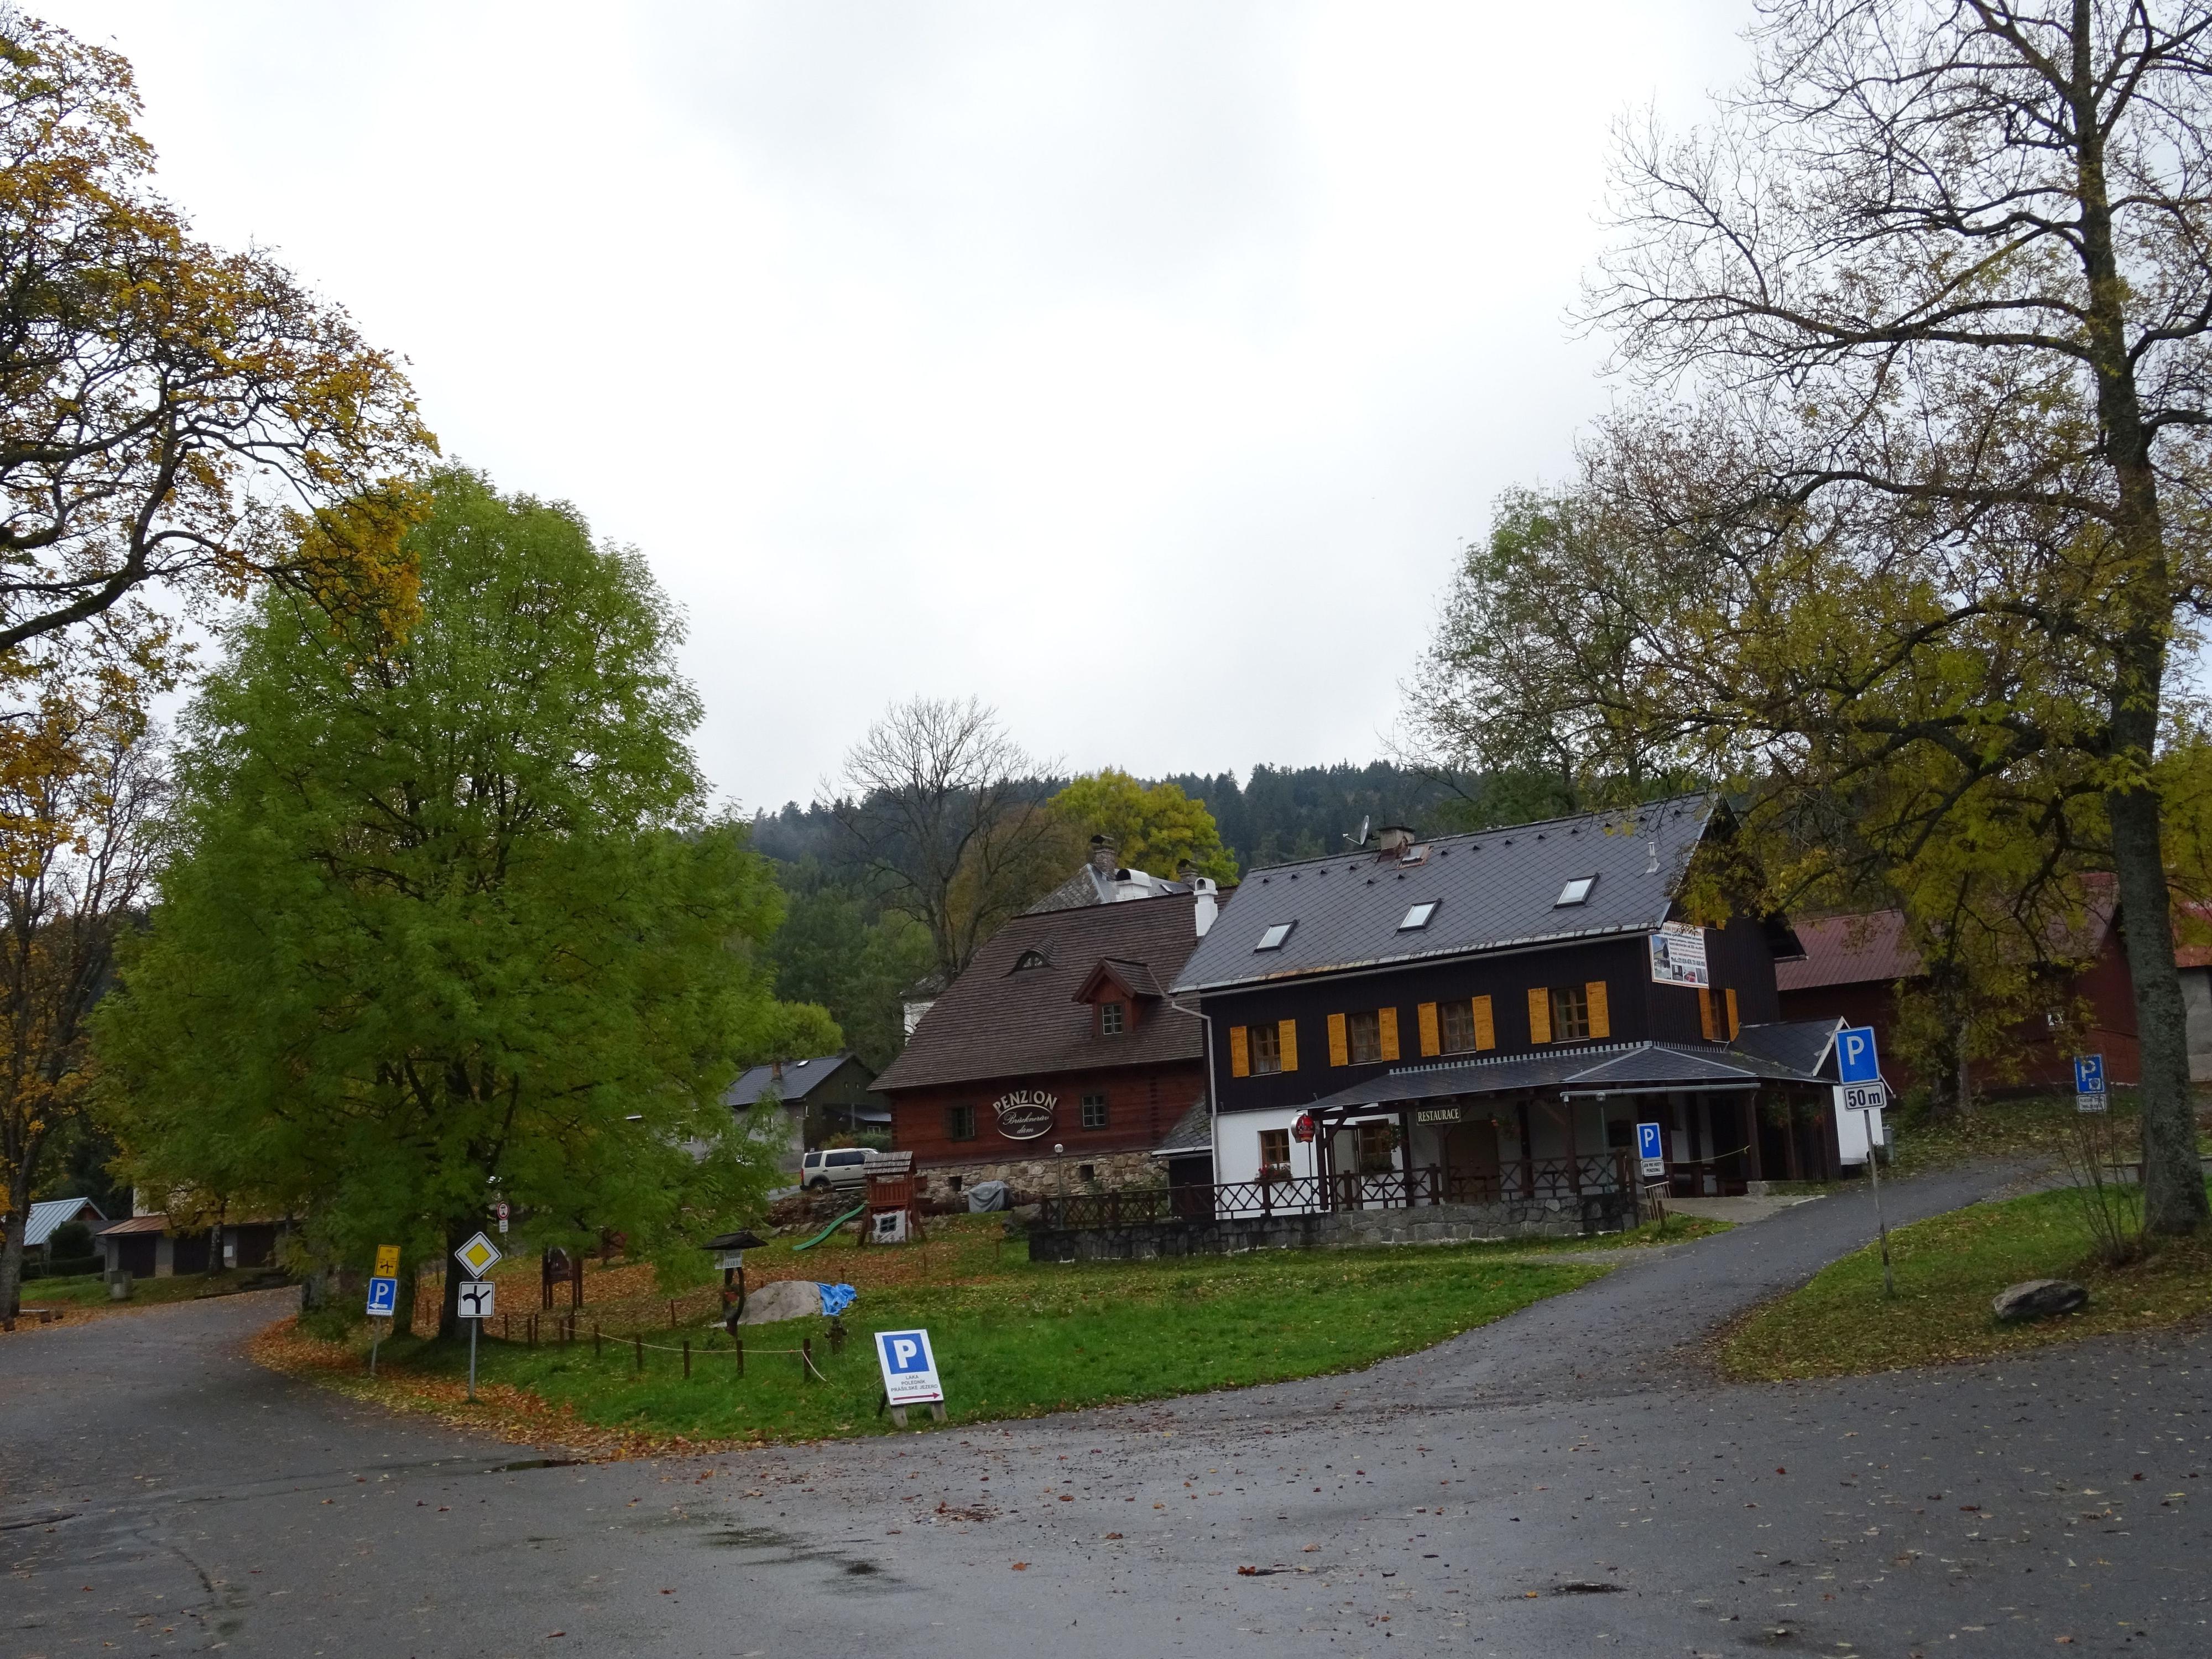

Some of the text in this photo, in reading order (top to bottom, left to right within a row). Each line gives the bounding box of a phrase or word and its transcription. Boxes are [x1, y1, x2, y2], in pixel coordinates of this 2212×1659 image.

[1846, 1036, 1864, 1065] P
[2081, 1060, 2096, 1082] P
[993, 1090, 1057, 1115] PENZION
[1848, 1089, 1881, 1107] 50 m
[1417, 1108, 1459, 1122] RESTAURACE
[1644, 1129, 1654, 1147] P
[375, 1283, 389, 1302] P
[893, 1339, 917, 1369] P
